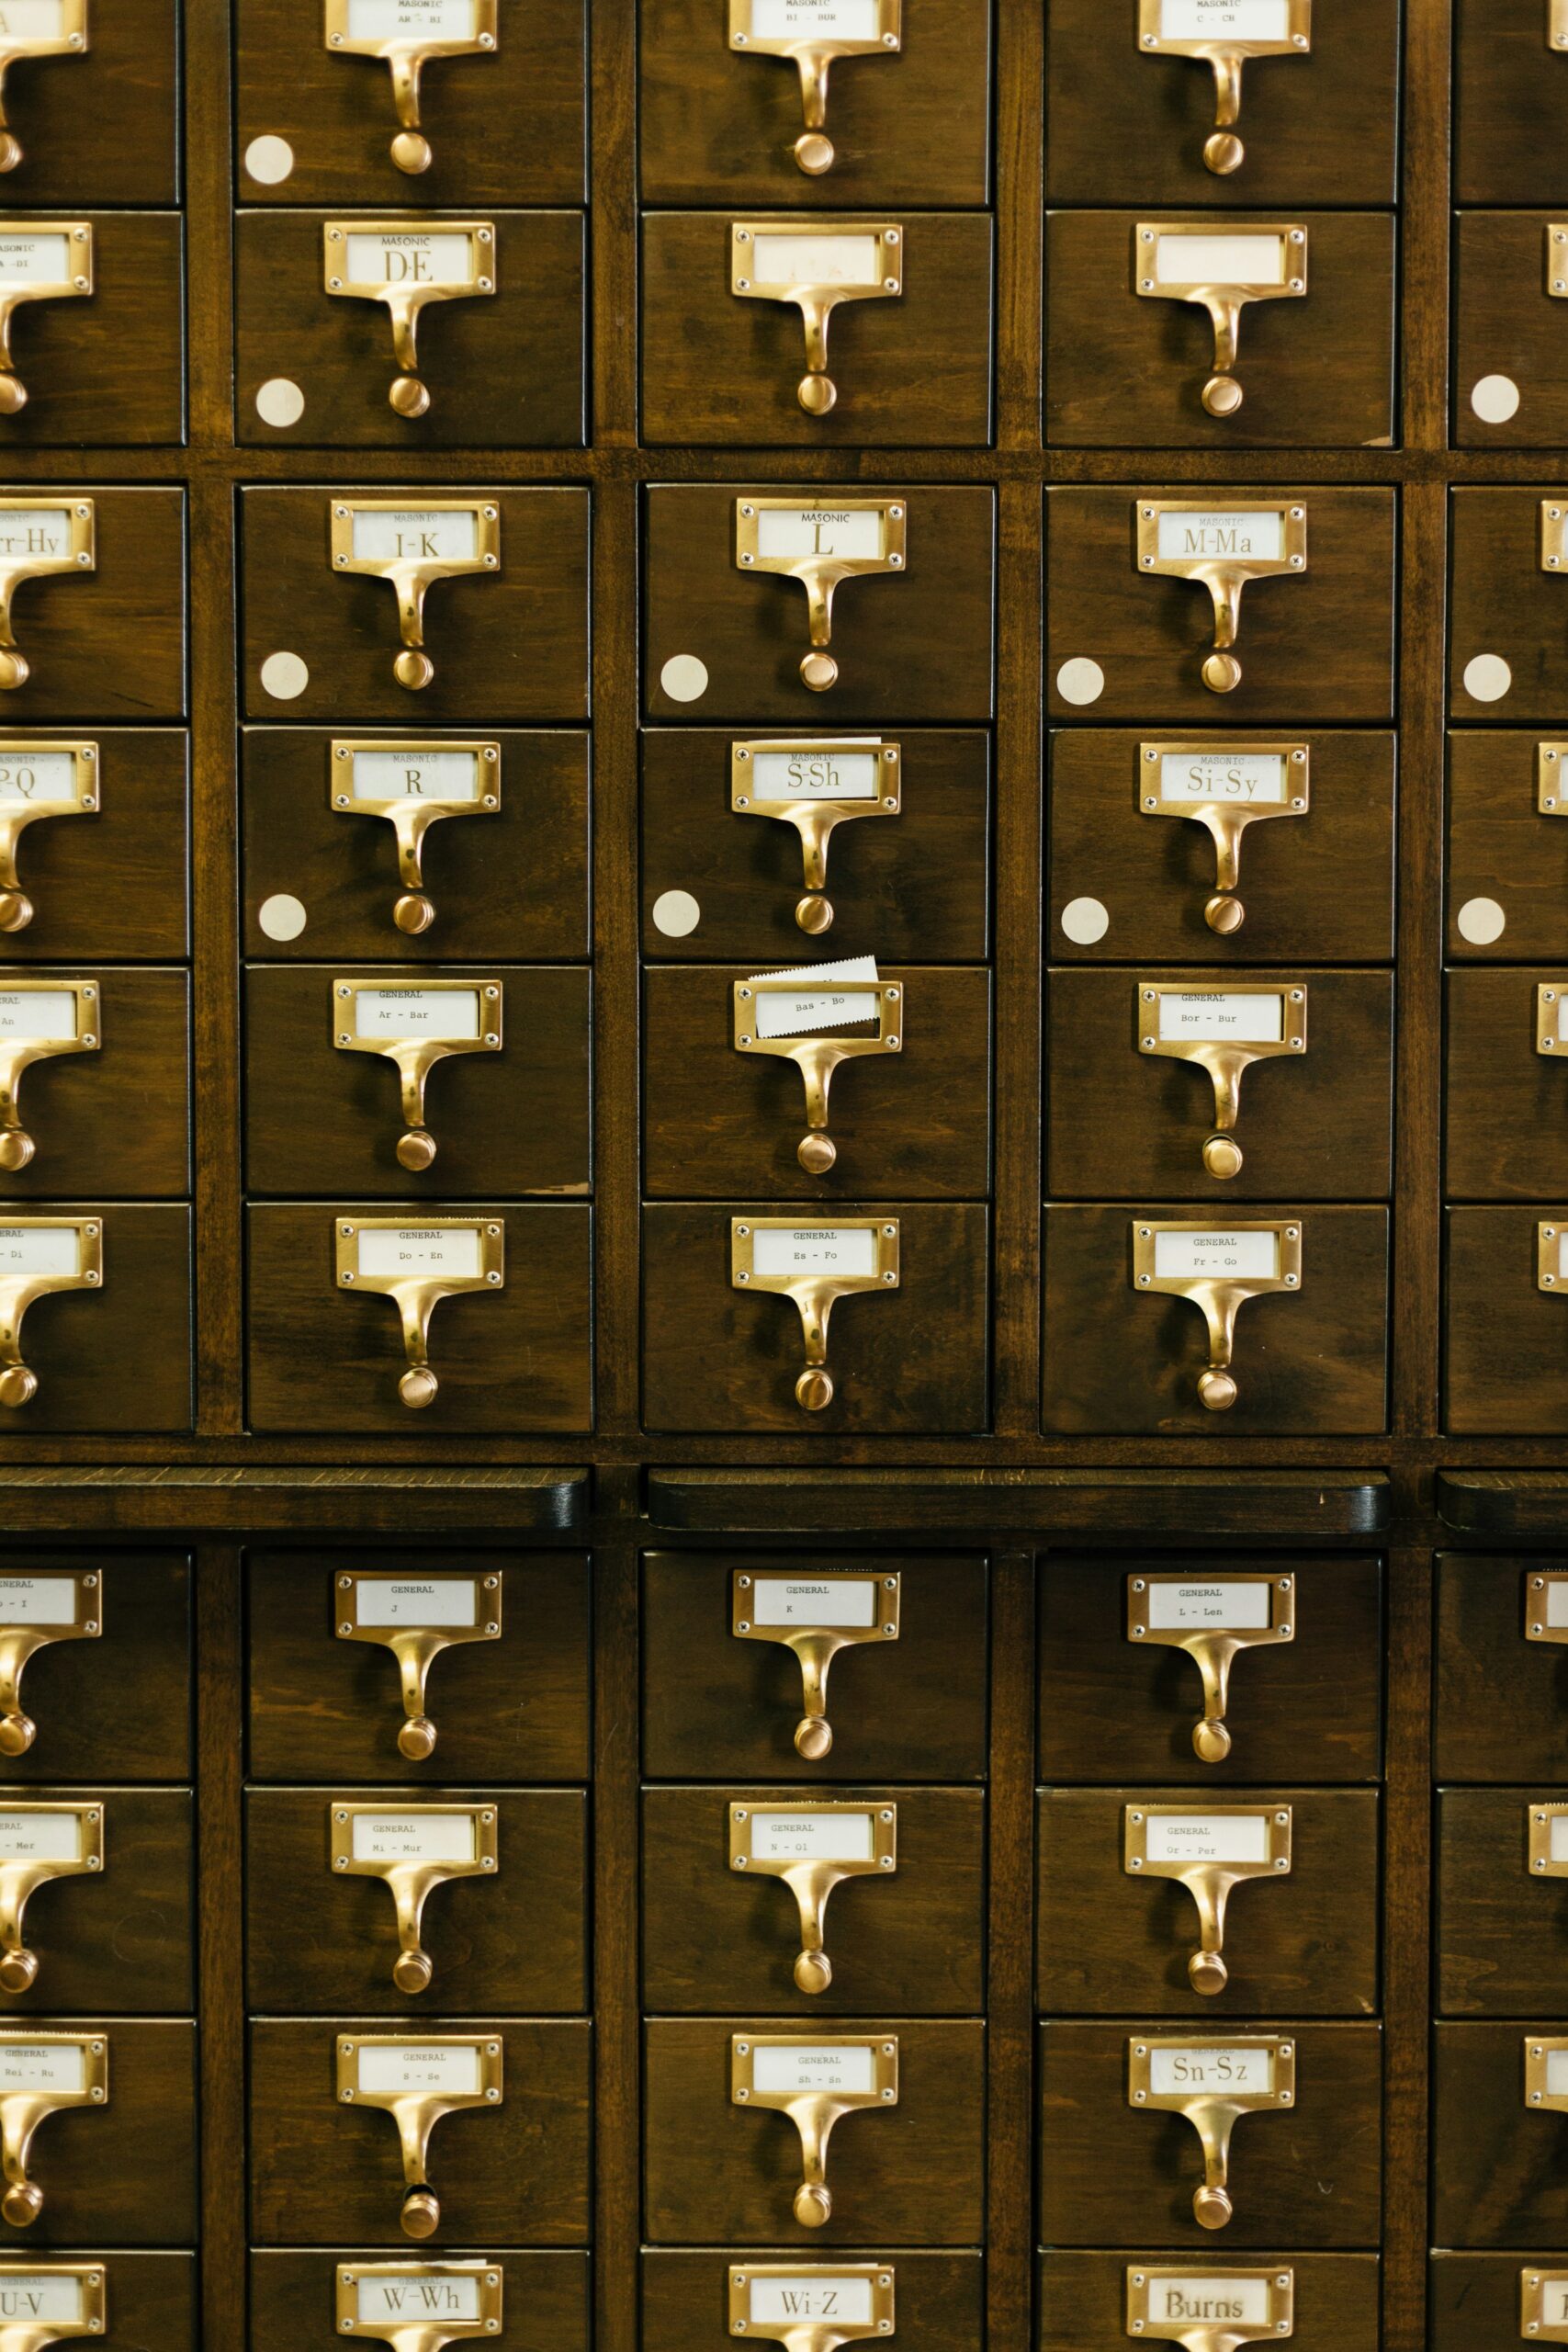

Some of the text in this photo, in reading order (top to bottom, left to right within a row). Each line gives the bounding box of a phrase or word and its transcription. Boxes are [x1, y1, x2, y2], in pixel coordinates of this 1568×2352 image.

[382, 237, 430, 246] MASONIC
[802, 513, 850, 523] MASONIC
[1200, 518, 1244, 526] MASONIC
[812, 524, 833, 555] L
[1184, 529, 1252, 553] M-Ma
[791, 753, 835, 762] MASONIC
[1201, 756, 1245, 765] MASONIC
[404, 770, 423, 794] R
[787, 763, 840, 788] S-Sh
[1187, 767, 1258, 801] Si-Sy
[379, 990, 423, 999] GENERAL
[795, 1002, 815, 1012] Bas
[832, 997, 845, 1005] Bo
[1219, 1014, 1237, 1023] Bur
[373, 1844, 385, 1852] Mi
[403, 1844, 422, 1852] Mur
[1198, 1847, 1216, 1855] Per
[0, 2292, 44, 2315] U-V
[383, 2286, 459, 2310] W-Wh
[782, 2291, 838, 2315] Wi-Z
[1166, 2290, 1243, 2318] Burns
